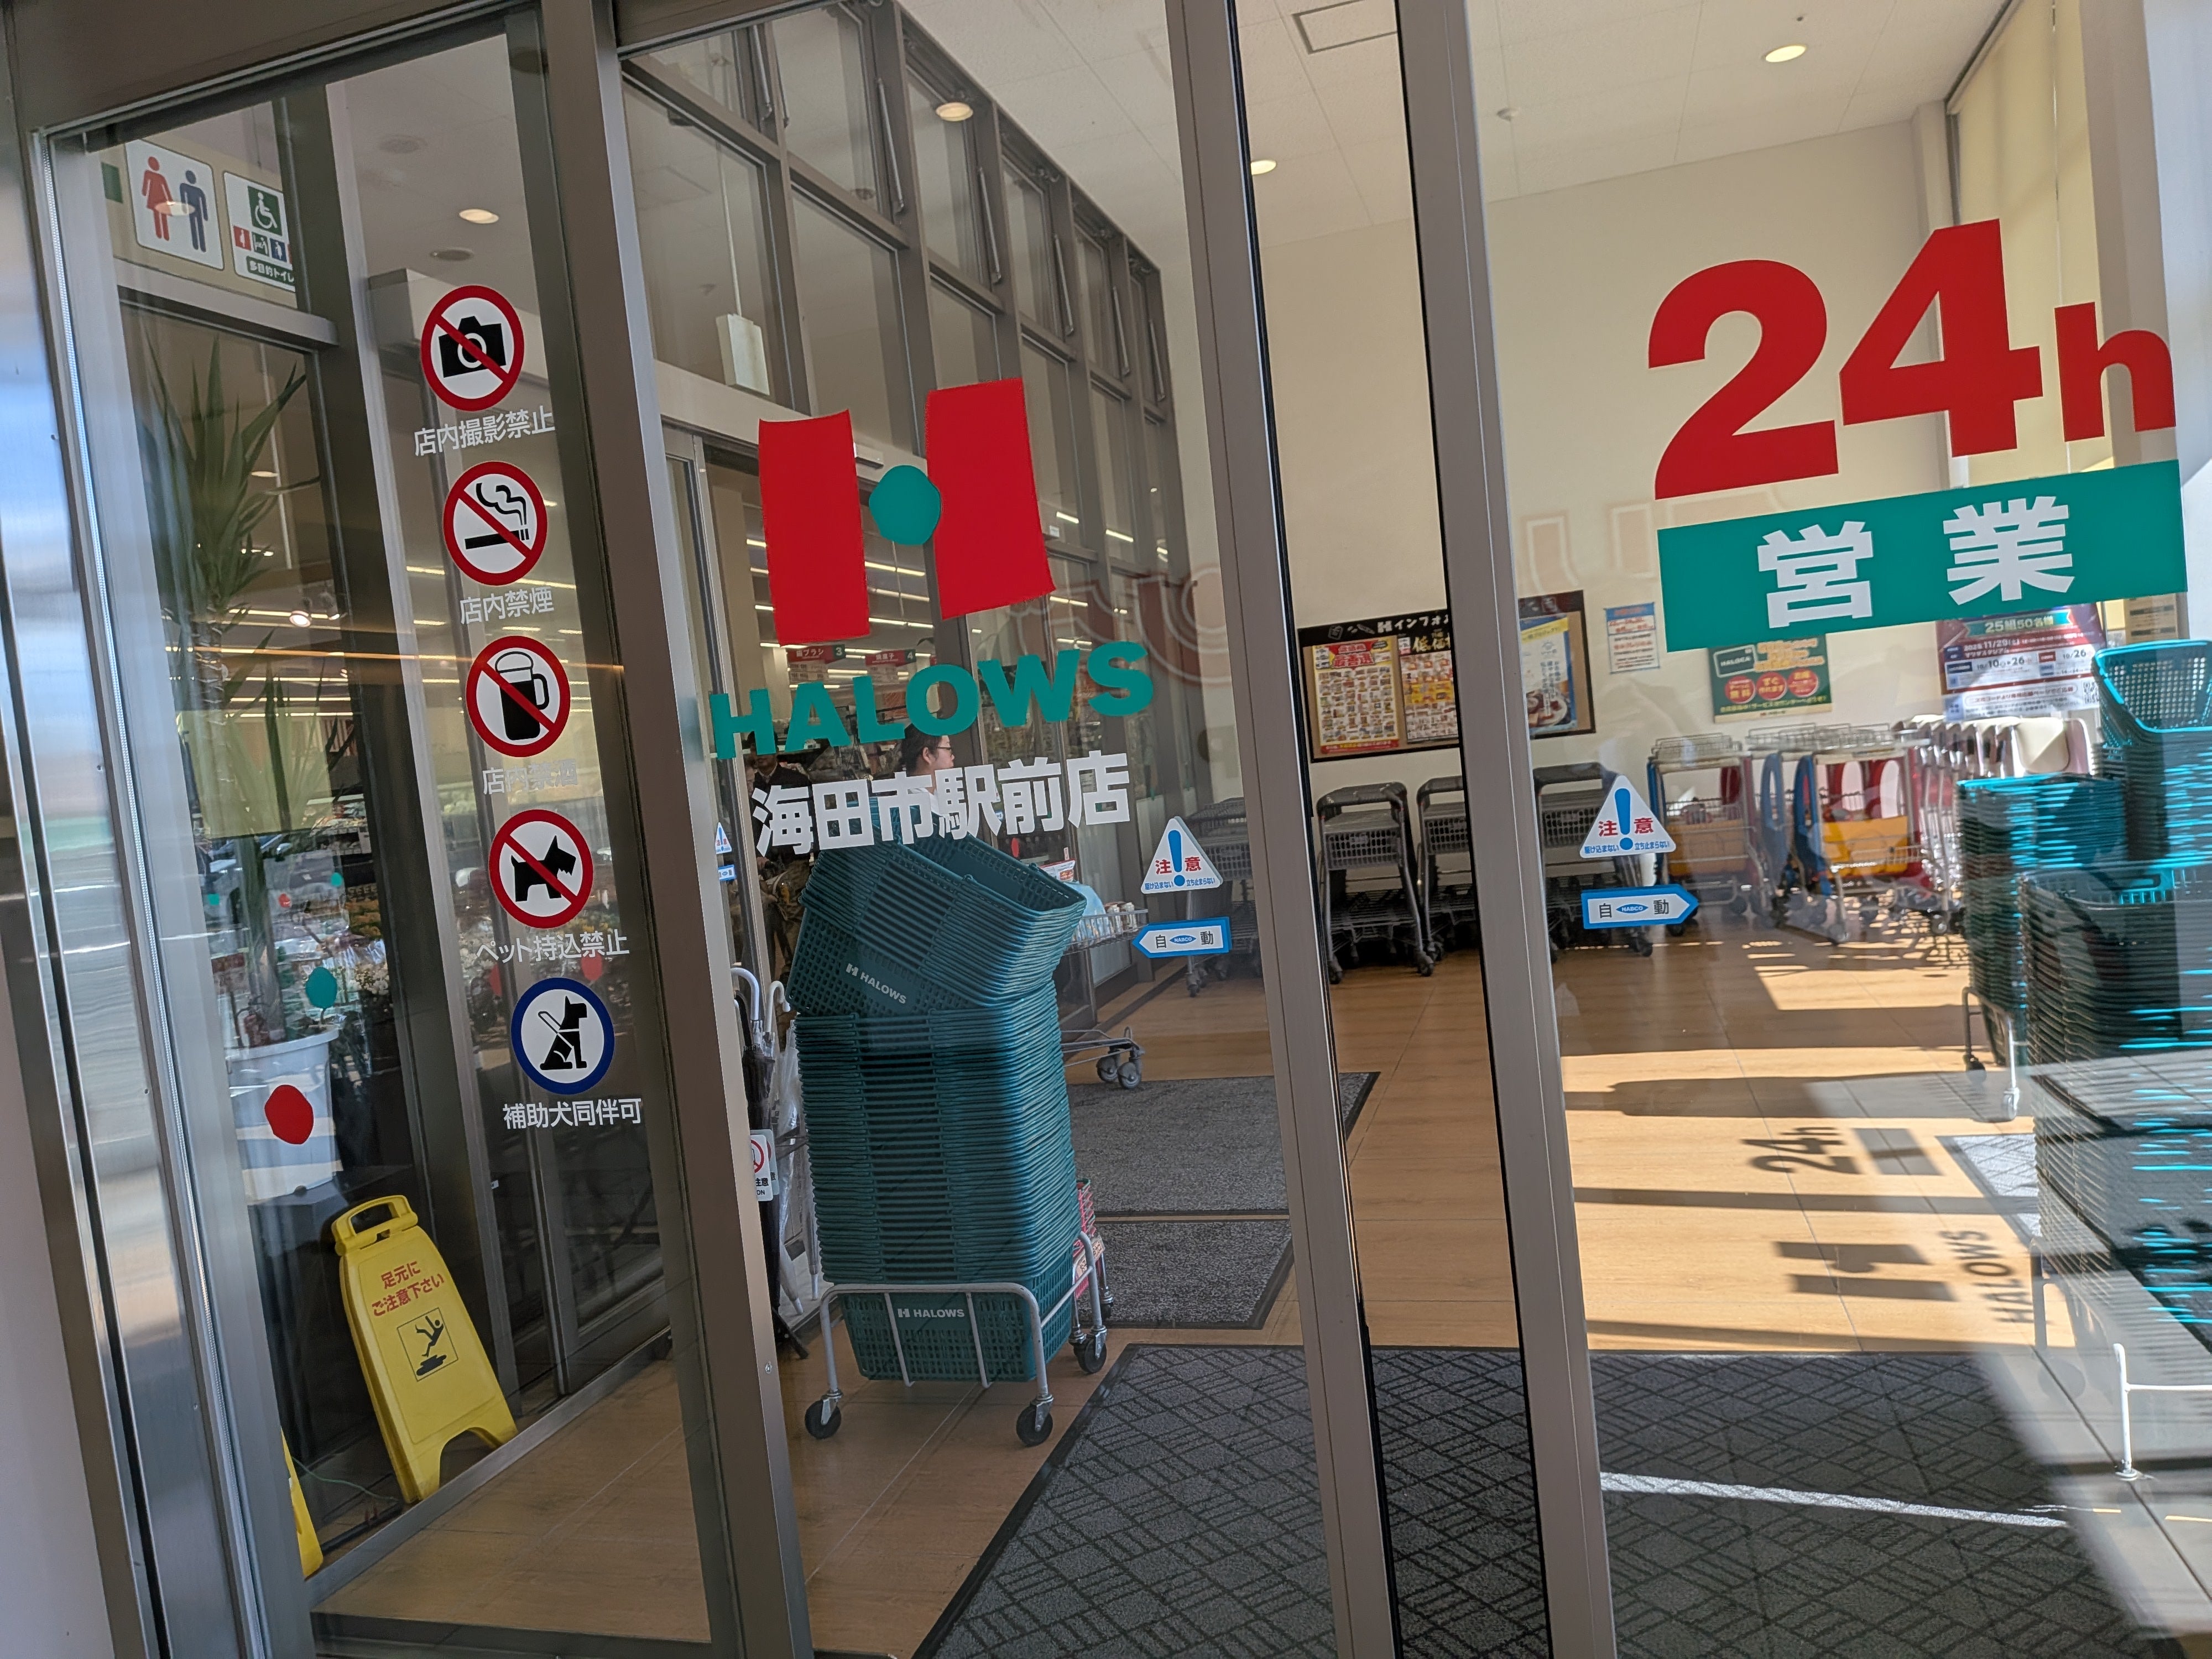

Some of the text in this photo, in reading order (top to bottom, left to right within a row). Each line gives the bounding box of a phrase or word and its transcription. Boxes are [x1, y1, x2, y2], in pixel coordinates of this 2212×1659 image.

[1649, 219, 2176, 499] 24h
[414, 406, 555, 456] 店内撮影禁止
[1757, 496, 2074, 628] 営業
[460, 587, 555, 625] 店内禁煙
[835, 646, 843, 656] 3
[709, 641, 1154, 759] HALOWS
[483, 759, 578, 795] 店内禁酒
[752, 750, 1130, 857] 海田市駅前店
[1635, 841, 1670, 851] 立ち止まらない
[477, 929, 630, 963] ペット持込禁止
[860, 971, 907, 1004] HALOWS
[503, 1098, 641, 1129] 補助犬同伴可
[381, 1261, 420, 1289] 足元に
[372, 1274, 445, 1317] ご注意下さい
[912, 1307, 965, 1319] HALOWS
